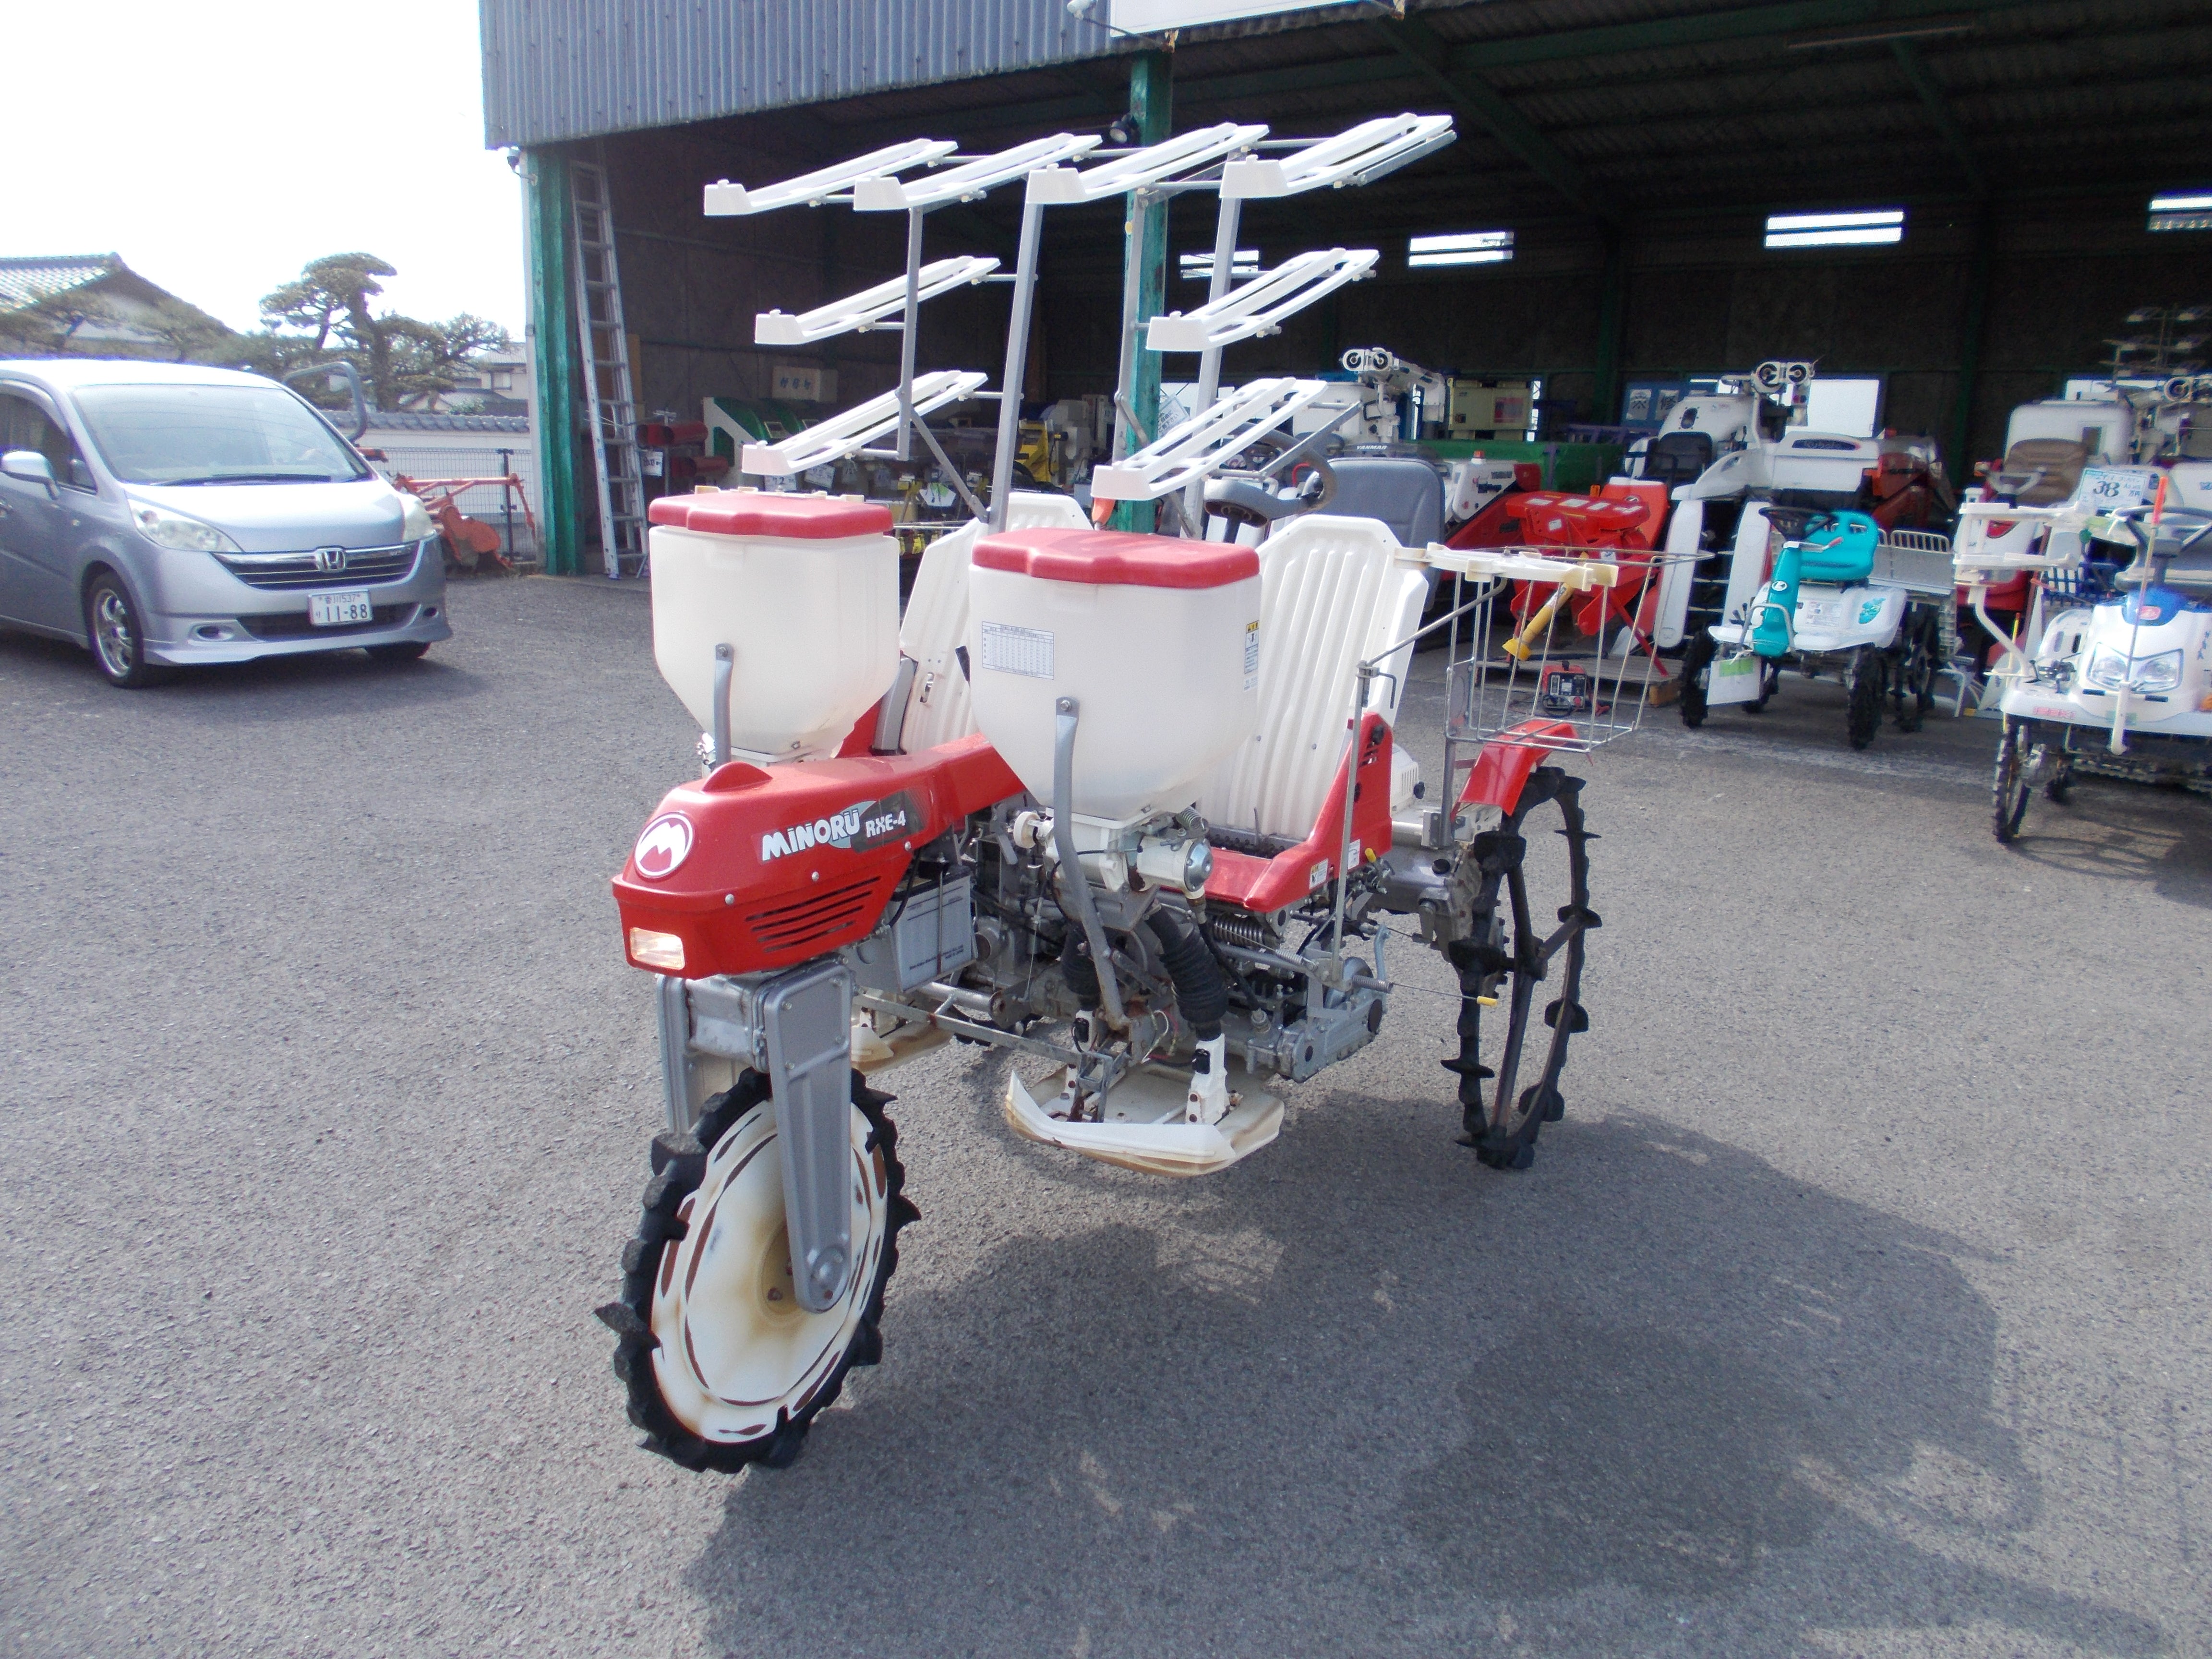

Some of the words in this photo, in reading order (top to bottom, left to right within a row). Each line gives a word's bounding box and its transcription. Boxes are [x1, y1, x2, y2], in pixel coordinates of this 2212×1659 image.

[2093, 481, 2120, 497] 38
[327, 604, 368, 621] 11-88
[866, 810, 906, 838] RXE-4
